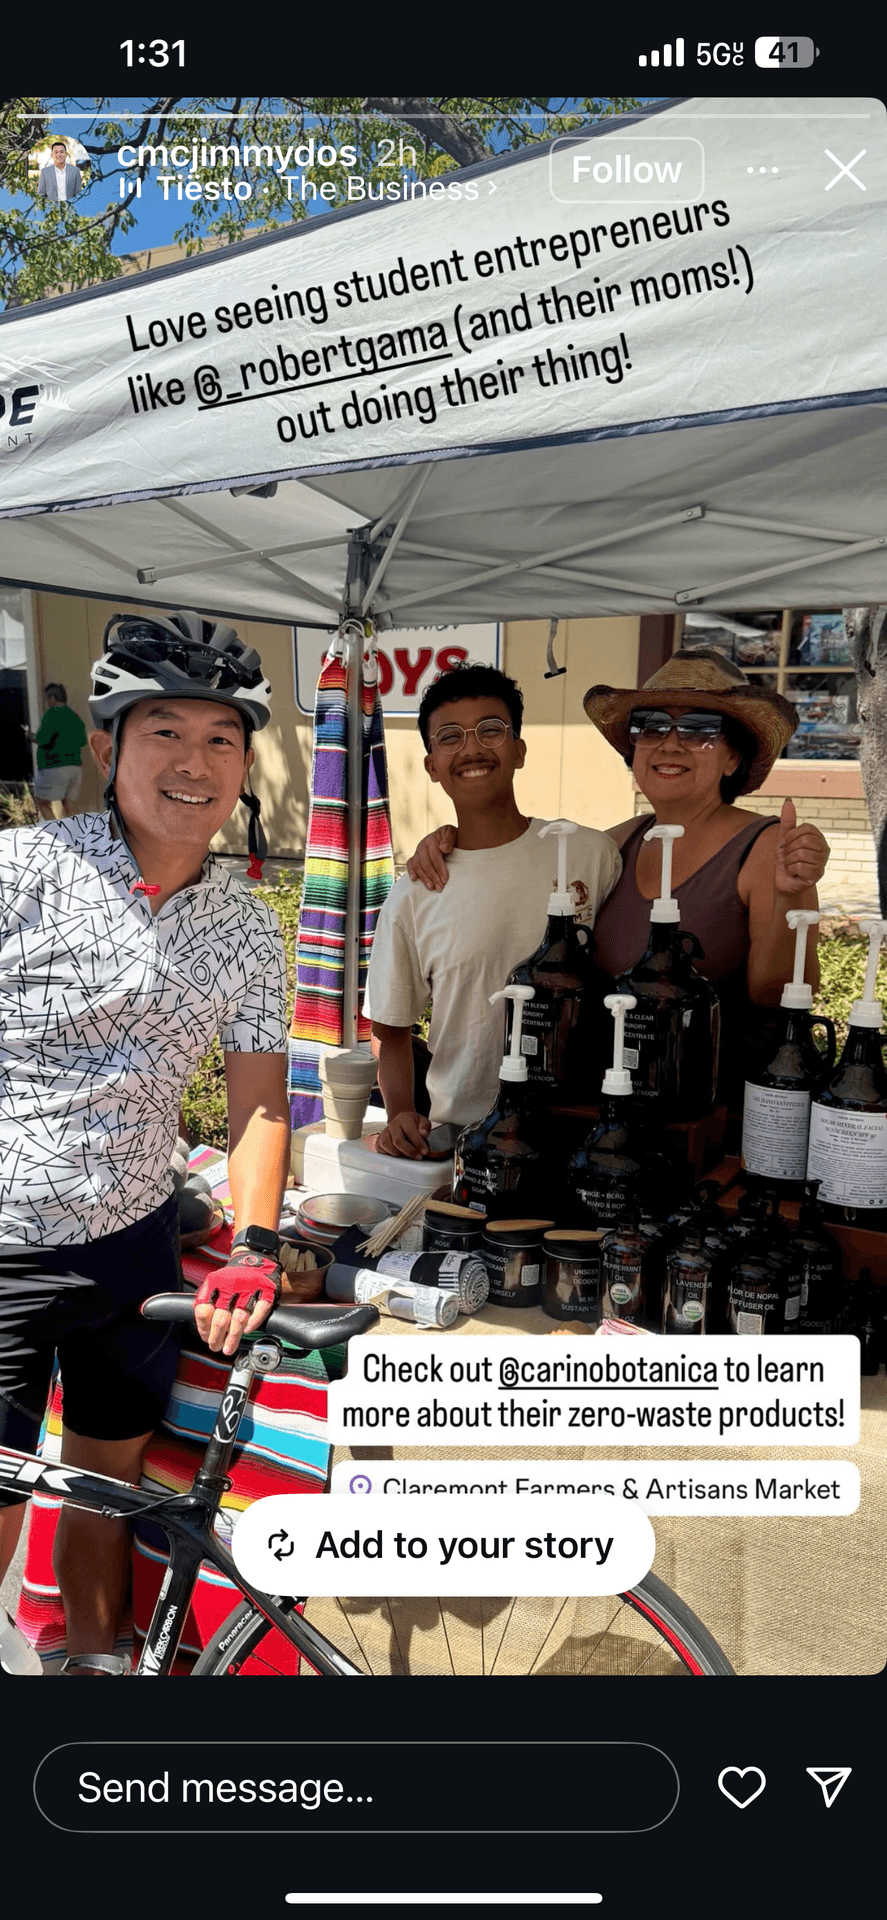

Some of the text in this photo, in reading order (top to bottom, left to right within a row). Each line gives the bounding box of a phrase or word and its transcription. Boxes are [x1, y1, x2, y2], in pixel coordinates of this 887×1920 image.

[634, 1013, 654, 1021] CLEAR
[471, 1185, 487, 1195] SOAP
[586, 1200, 605, 1209] HAND
[598, 1211, 617, 1219] SOAP
[602, 1260, 643, 1273] PEPPERMINT
[614, 1274, 626, 1282] OIL
[675, 1278, 713, 1289] LAVENDER
[687, 1291, 700, 1299] OIL
[744, 1291, 756, 1299] DE
[756, 1292, 779, 1300] NOPAL
[561, 1303, 589, 1312] SUSTAIN
[729, 1296, 775, 1311] DIFFUSER OIL
[218, 1609, 253, 1651] Panaracer
